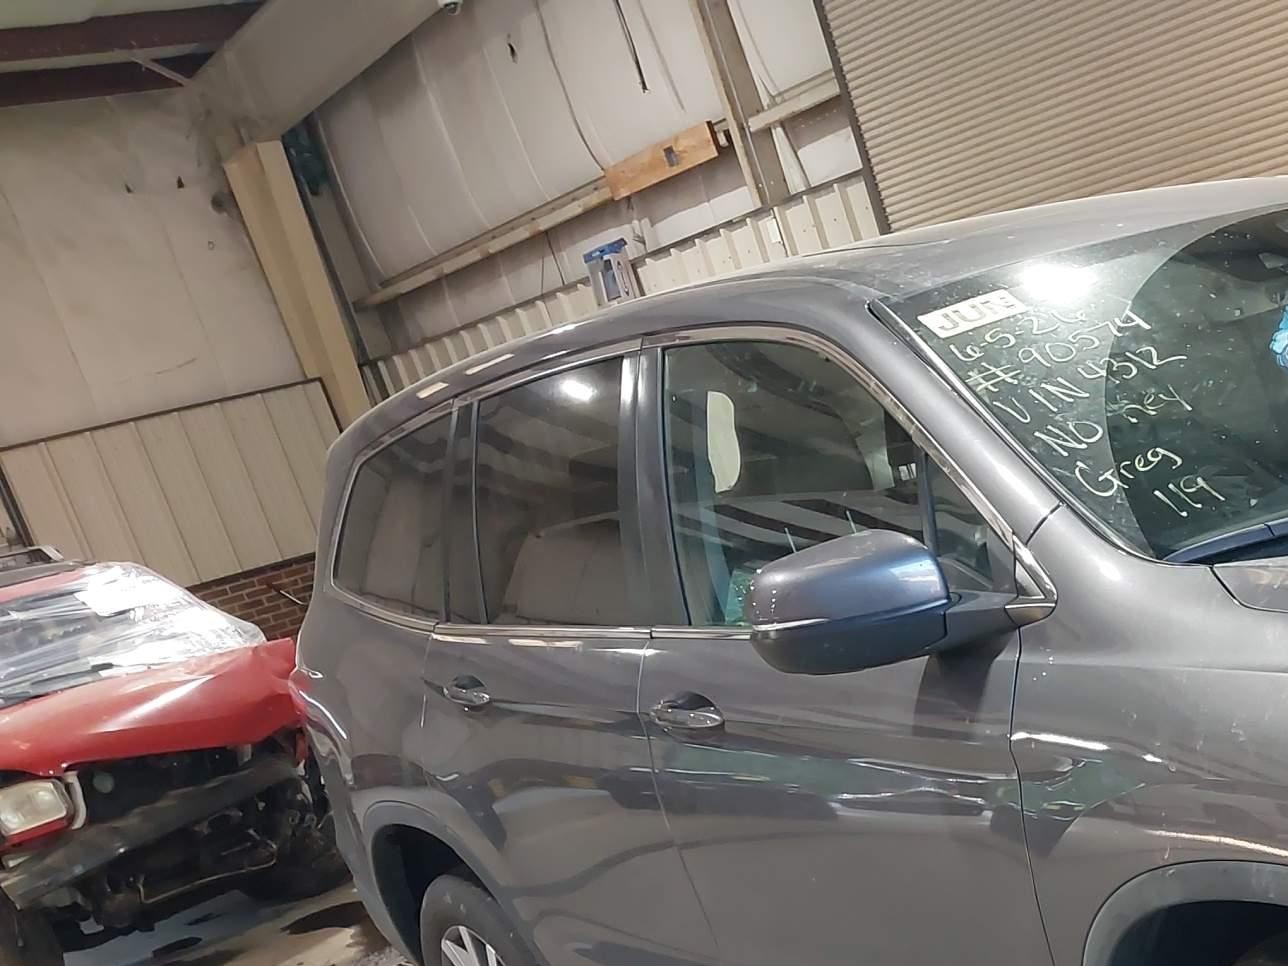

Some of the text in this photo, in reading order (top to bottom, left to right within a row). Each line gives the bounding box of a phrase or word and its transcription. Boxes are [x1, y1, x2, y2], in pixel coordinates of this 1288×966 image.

[993, 346, 1188, 423] VIN 4312
[1034, 420, 1104, 457] NO
[1074, 448, 1183, 497] Greg
[1152, 474, 1226, 517] 119
